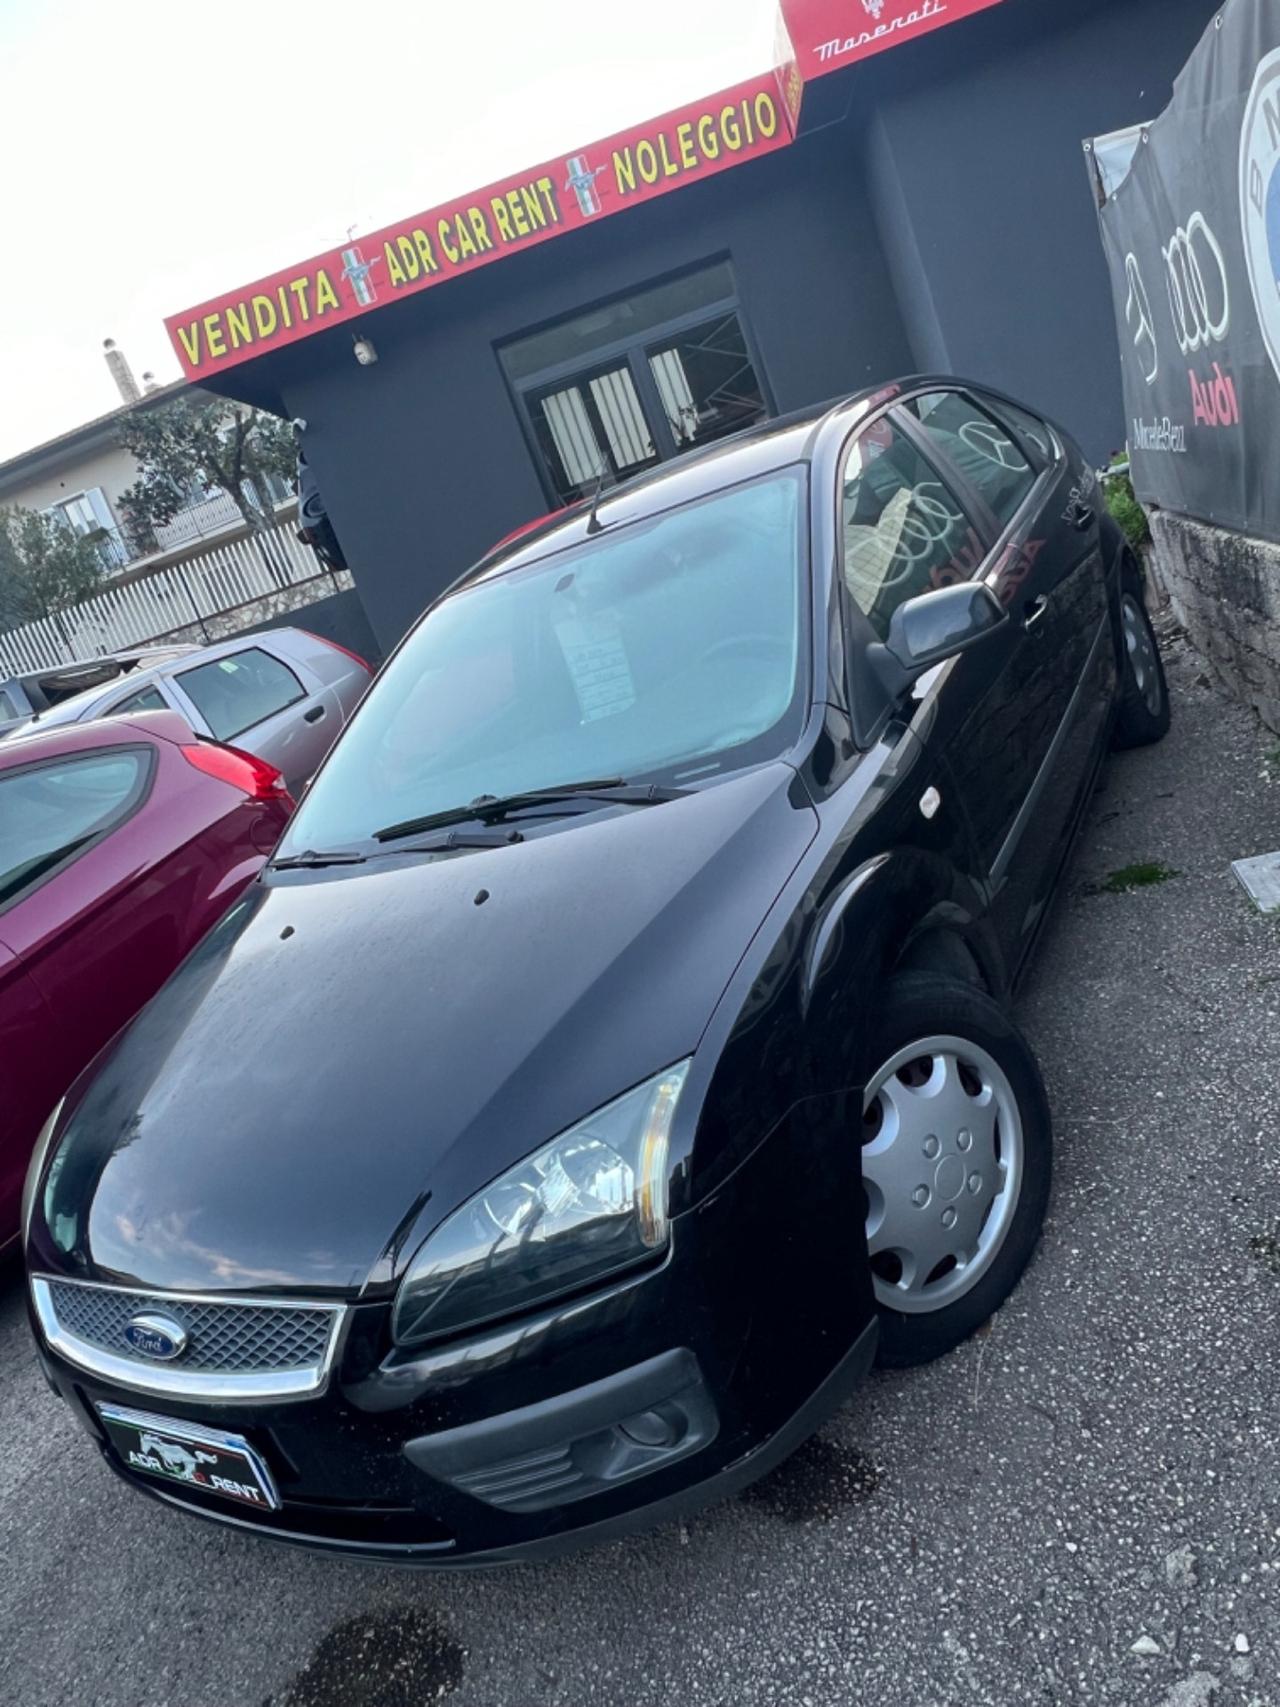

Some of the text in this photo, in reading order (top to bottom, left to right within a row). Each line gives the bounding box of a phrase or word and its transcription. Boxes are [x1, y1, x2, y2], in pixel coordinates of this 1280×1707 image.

[813, 0, 947, 61] Maserati
[177, 92, 777, 365] VENDITA ADR CAR RENT NOLEGGIO
[1188, 361, 1239, 426] Audi
[129, 1450, 165, 1473] ADR
[209, 1474, 260, 1502] RENT
